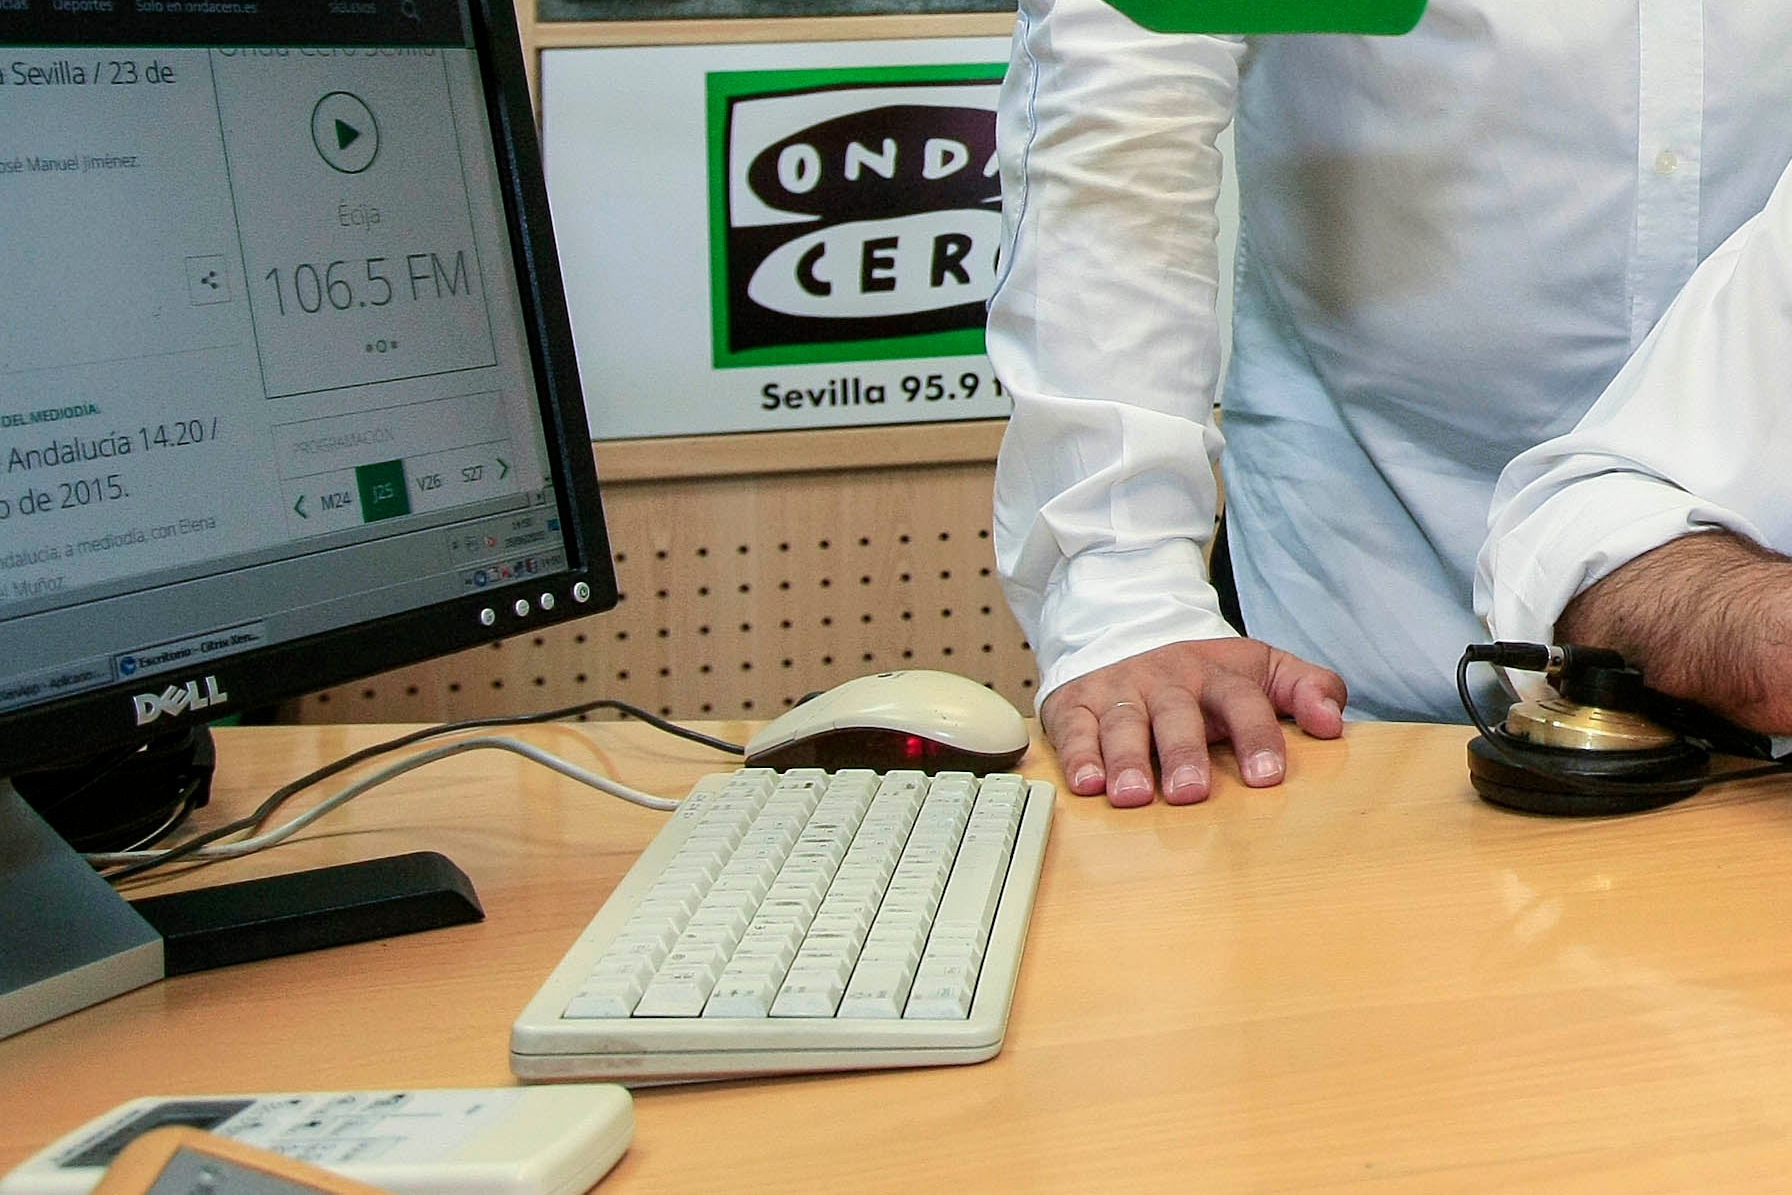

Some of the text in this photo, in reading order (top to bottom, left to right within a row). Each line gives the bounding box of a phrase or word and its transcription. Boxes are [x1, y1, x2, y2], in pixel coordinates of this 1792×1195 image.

[167, 1, 185, 12] en
[187, 0, 257, 14] ondacero.es
[12, 60, 86, 85] Sevilla
[93, 61, 101, 85] /
[110, 61, 138, 85] 23
[145, 60, 176, 84] de
[26, 154, 80, 172] Manuel
[264, 250, 471, 316] 106.5 FM
[794, 233, 1002, 297] CER
[761, 377, 886, 411] Sevilla
[900, 372, 980, 403] 95.9
[8, 417, 218, 473] Andalucía 14.20 /
[19, 488, 51, 515] de
[60, 474, 129, 510] 2015.
[320, 492, 351, 510] M24
[416, 473, 442, 491] V26
[461, 465, 484, 482] S27
[152, 524, 177, 540] con
[180, 517, 216, 535] Elena
[139, 647, 192, 667] Escritorio
[132, 674, 228, 726] DELL
